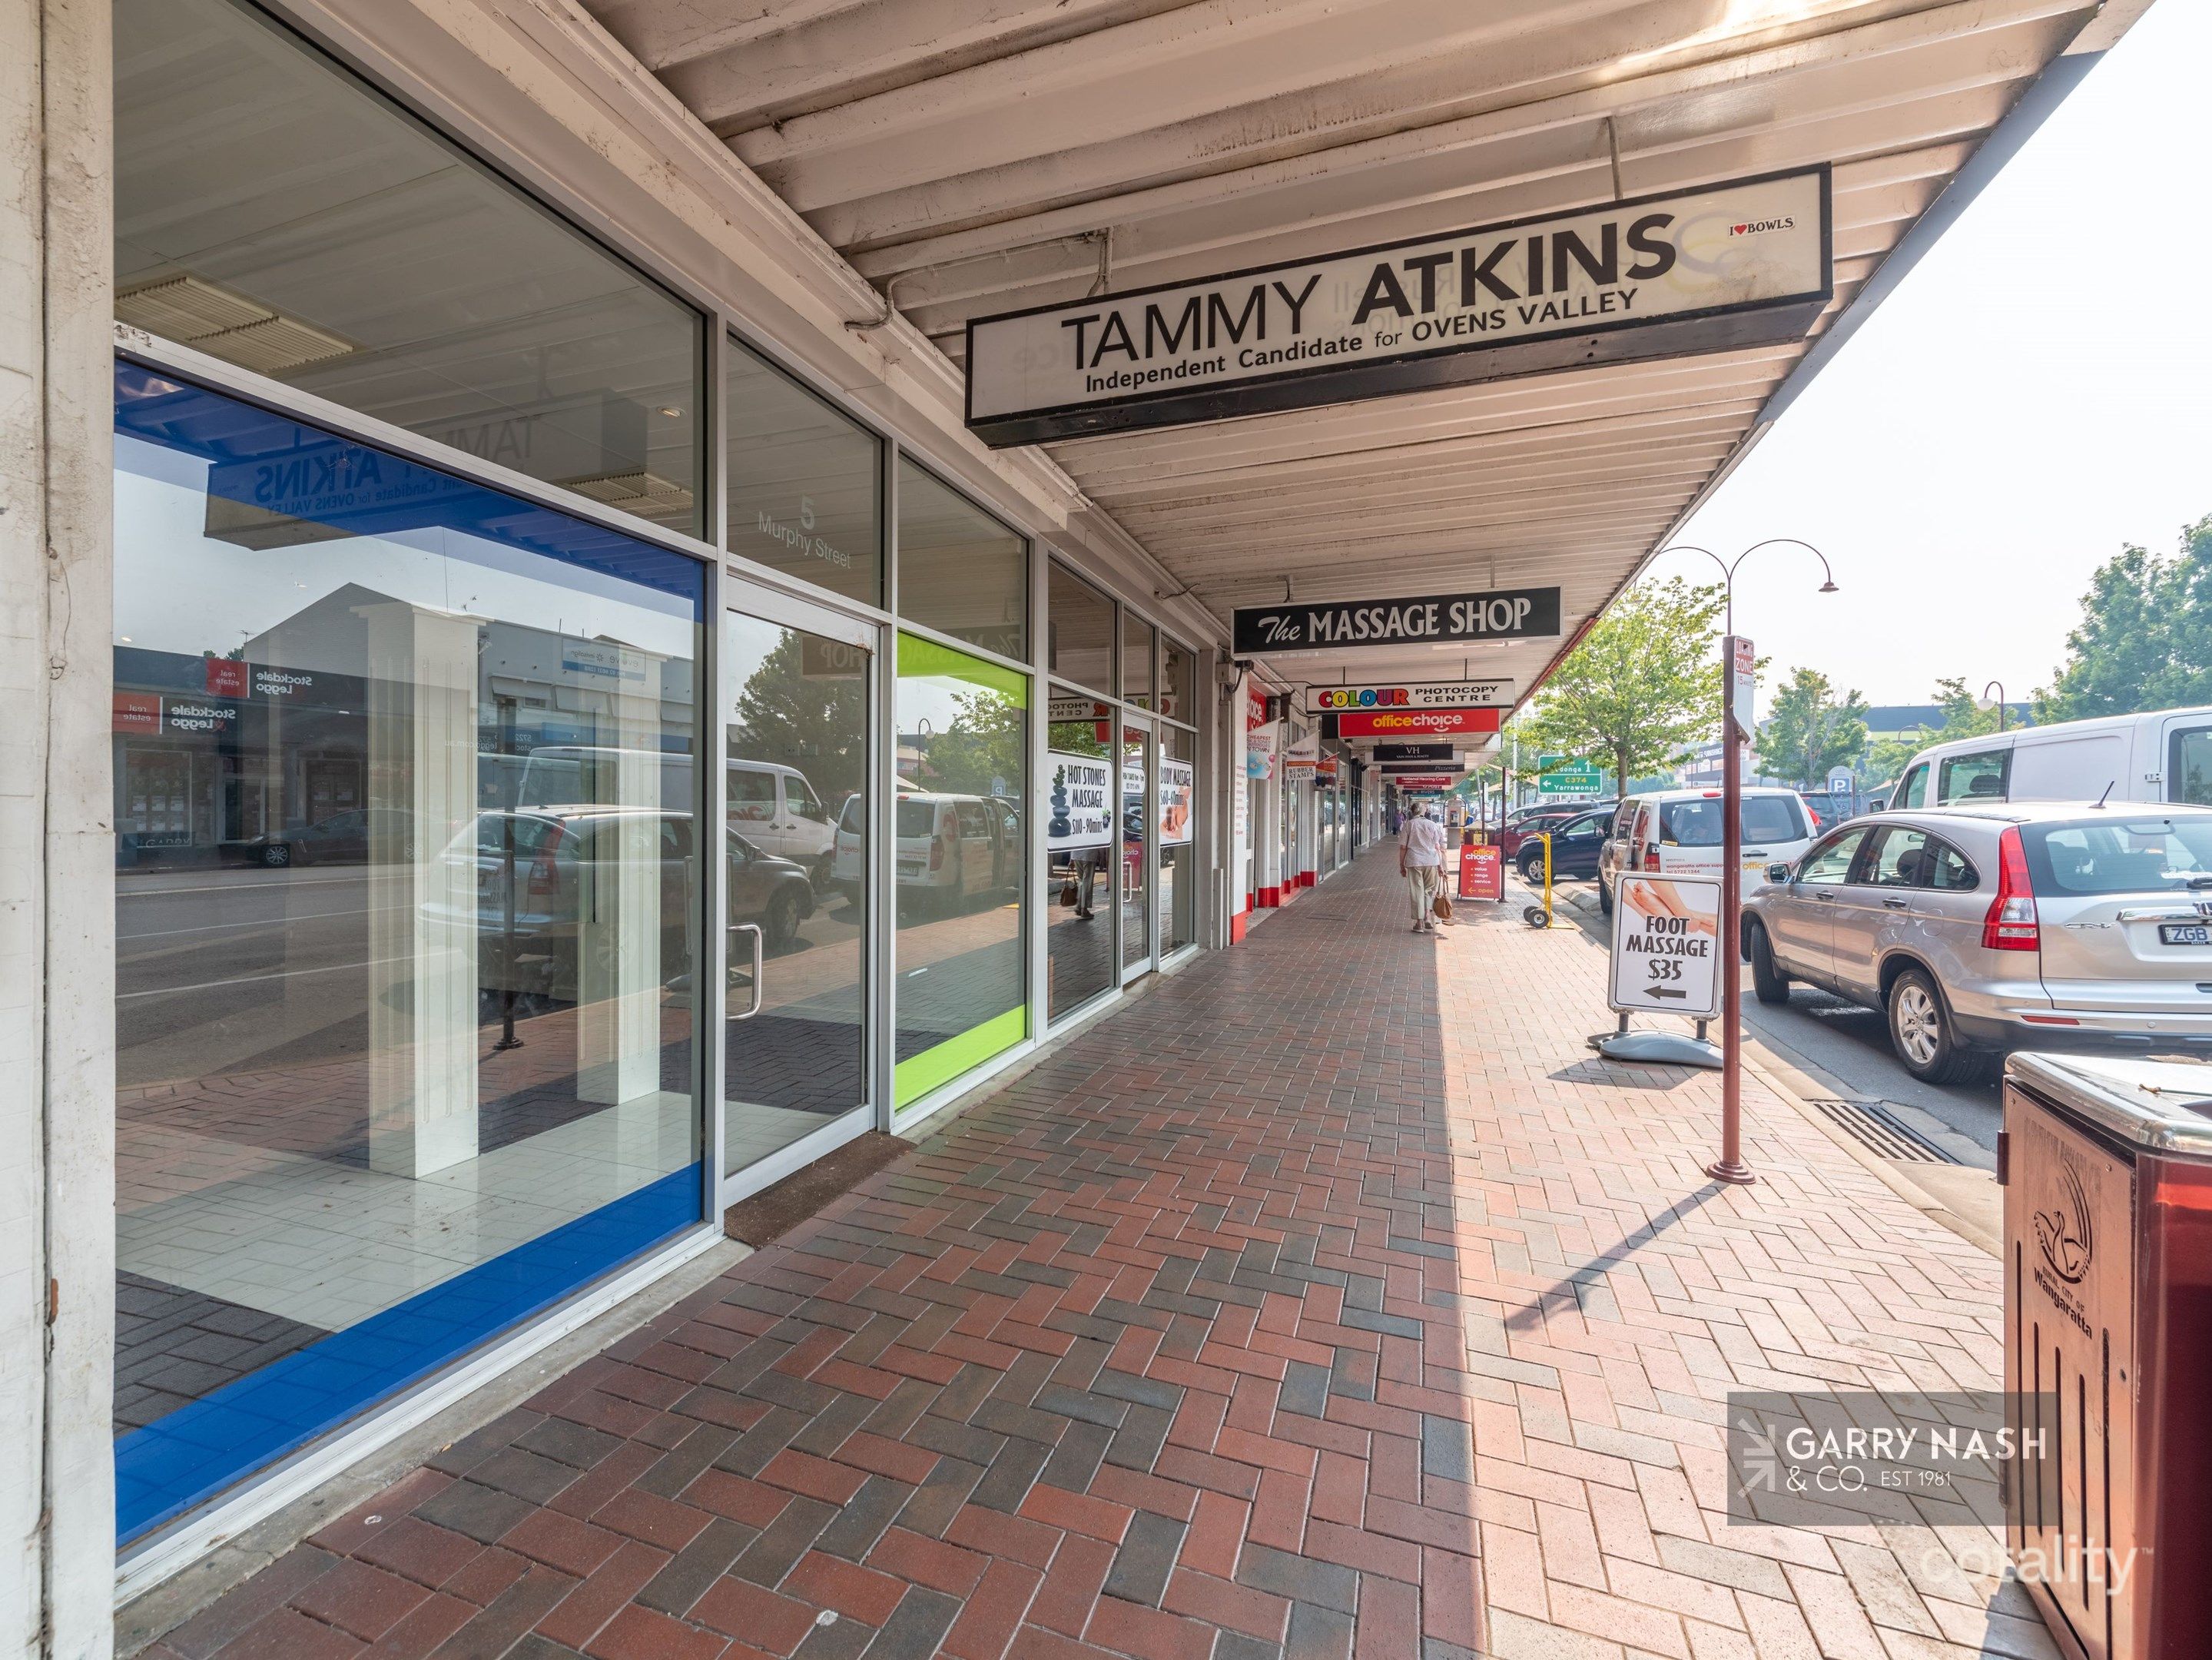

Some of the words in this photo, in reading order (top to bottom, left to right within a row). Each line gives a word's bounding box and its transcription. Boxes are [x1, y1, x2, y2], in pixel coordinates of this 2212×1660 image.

[1747, 217, 1794, 234] BOWLS
[1061, 274, 1322, 370] TAMMY
[1351, 213, 1677, 325] ATKINS
[1086, 355, 1226, 393] Independent
[1239, 336, 1363, 369] Candidate
[1375, 330, 1403, 348] for
[1411, 309, 1507, 341] OVENS
[1517, 287, 1639, 325] VALLEY
[801, 494, 815, 530] 5
[758, 510, 812, 556] Murphy
[815, 537, 851, 569] Street
[1258, 615, 1301, 643] The
[1308, 604, 1441, 642] MASSAGE
[1449, 597, 1532, 634] SHOP
[1736, 657, 1753, 674] ZONE
[1318, 688, 1411, 709] COLOUR
[1414, 686, 1499, 696] PHOTOCOPY
[1423, 694, 1491, 703] CENTRE
[1068, 765, 1082, 785] HOT
[1083, 766, 1106, 787] STONES
[1160, 765, 1172, 785] BODY
[1172, 768, 1191, 787] MASSAGE
[1834, 779, 1846, 792] P
[1072, 788, 1103, 808] MASSAGE
[1464, 853, 1494, 862] choice
[1646, 915, 1690, 936] FOOT
[2171, 928, 2208, 941] ZGB
[1625, 935, 1709, 958] MASSAGE
[1647, 958, 1683, 981] $35
[2042, 1265, 2060, 1290] RURAL
[2061, 1286, 2074, 1303] CITY
[2076, 1300, 2085, 1313] OF
[2034, 1266, 2093, 1340] Wangaratta
